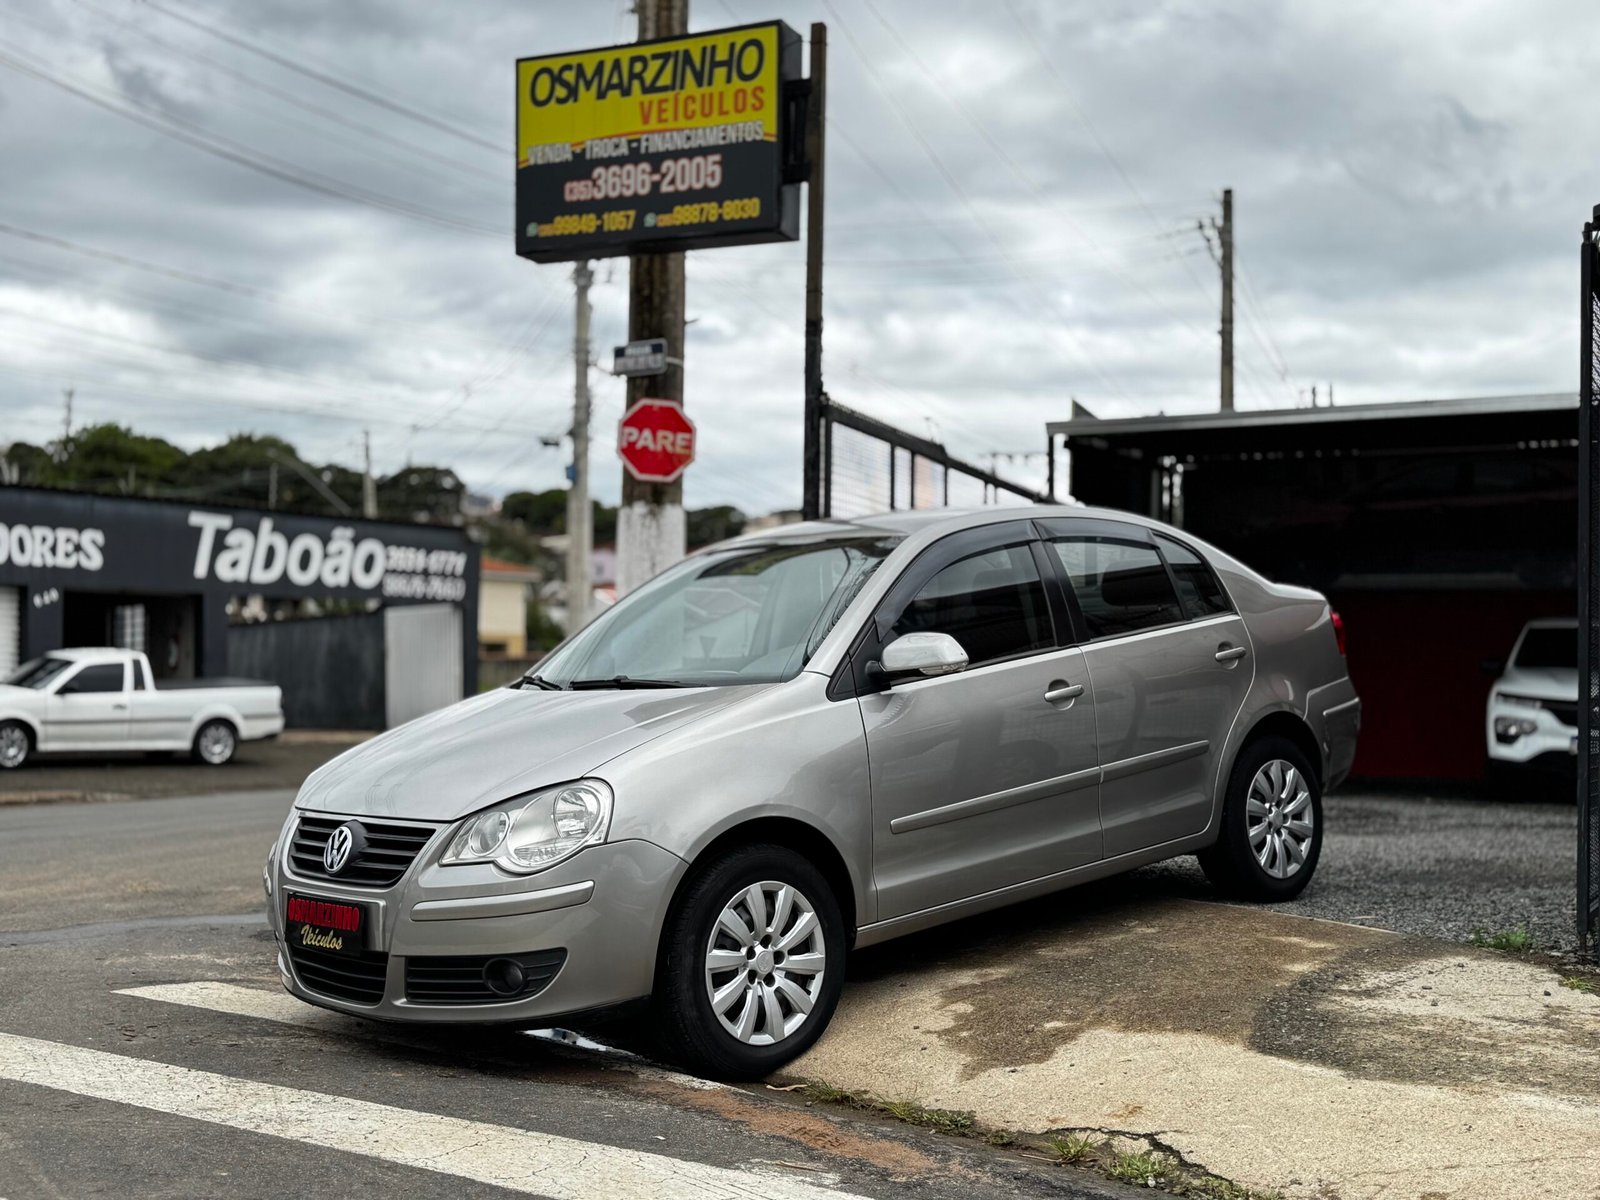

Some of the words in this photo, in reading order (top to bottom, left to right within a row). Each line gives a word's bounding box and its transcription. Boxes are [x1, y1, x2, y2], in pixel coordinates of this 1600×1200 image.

[529, 38, 765, 107] OSMARZINHO
[639, 86, 765, 125] VEÍCULOS
[528, 142, 573, 165] VENDA
[584, 137, 629, 160] TROCA
[640, 120, 764, 154] FINANCIAMENTOS
[620, 425, 692, 455] PARE
[187, 510, 387, 590] Taboão
[288, 897, 360, 932] OSMARZINHO
